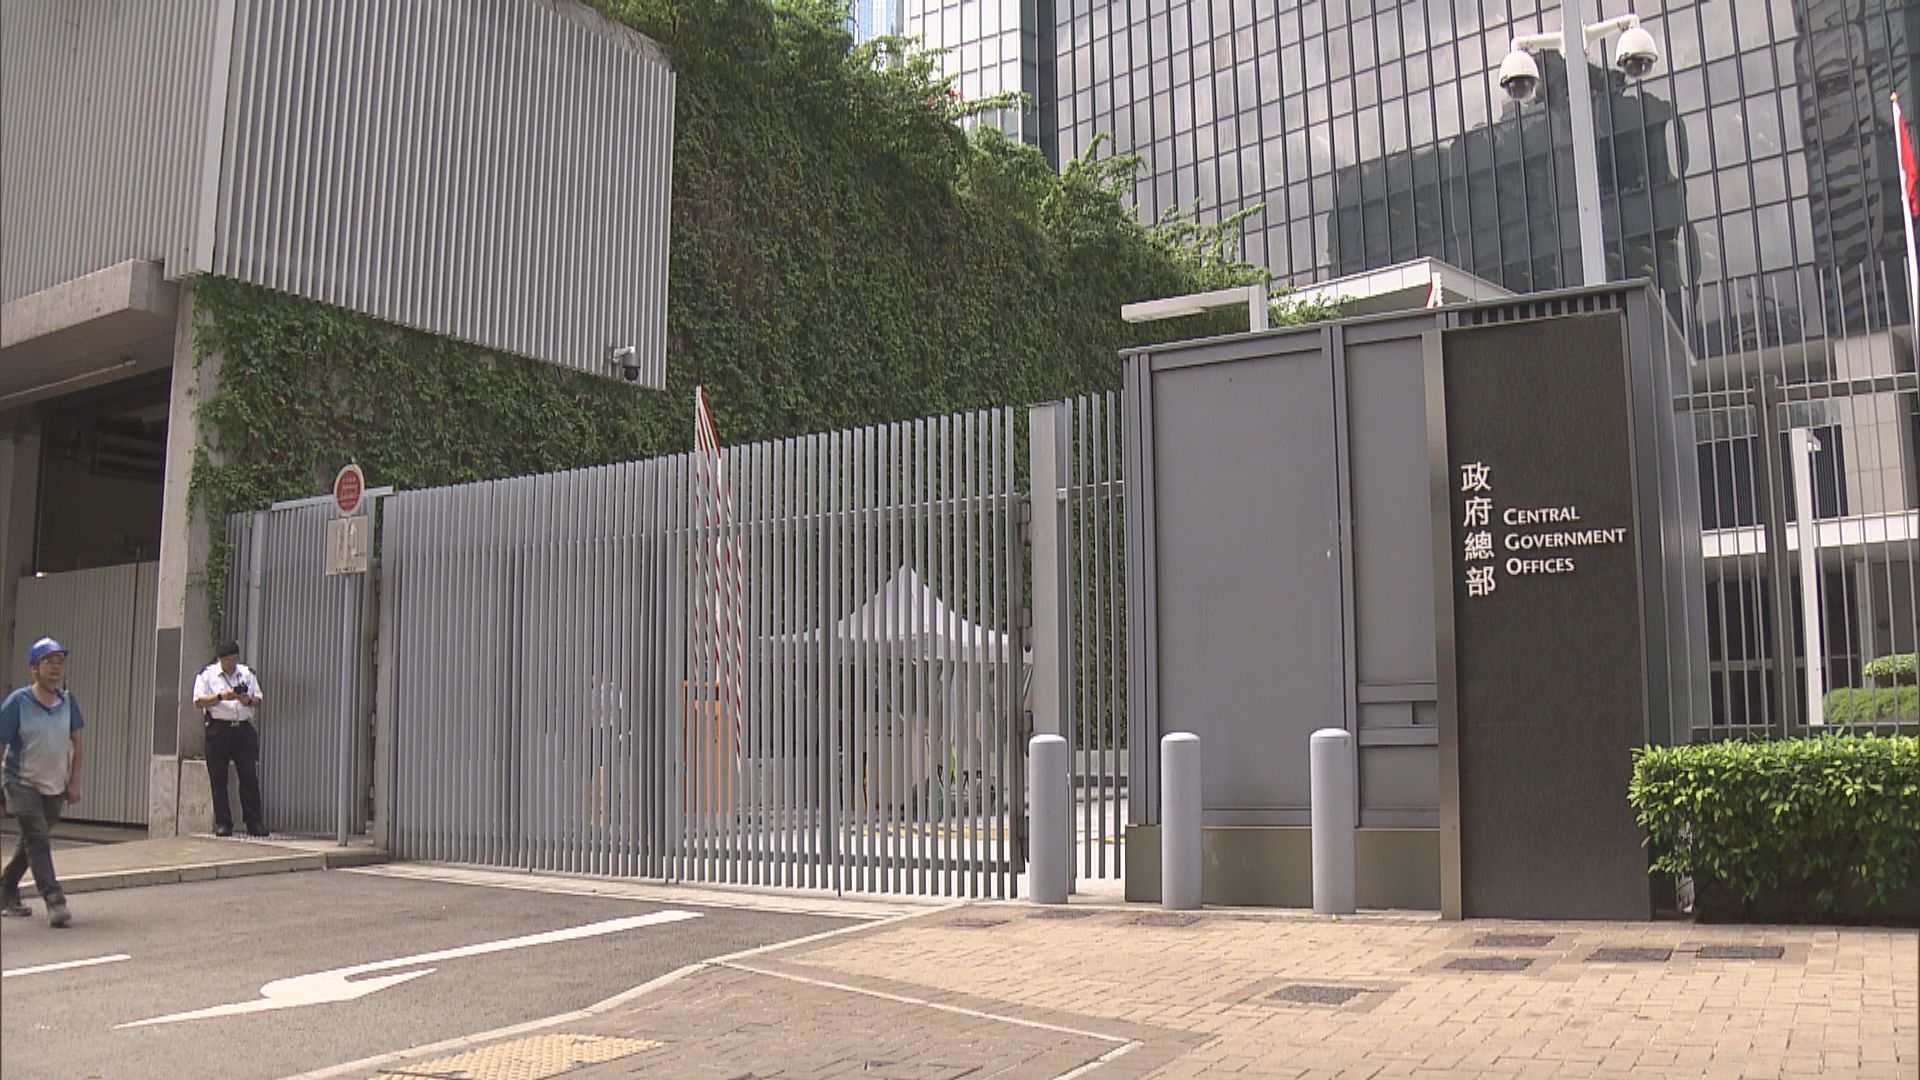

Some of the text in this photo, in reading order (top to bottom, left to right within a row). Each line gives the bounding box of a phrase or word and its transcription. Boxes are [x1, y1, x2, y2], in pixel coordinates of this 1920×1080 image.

[1503, 506, 1580, 526] CENTRAL
[1460, 460, 1496, 597] 政府總部
[1504, 528, 1627, 550] GOVERNMENT
[1505, 557, 1575, 576] OFFICES
